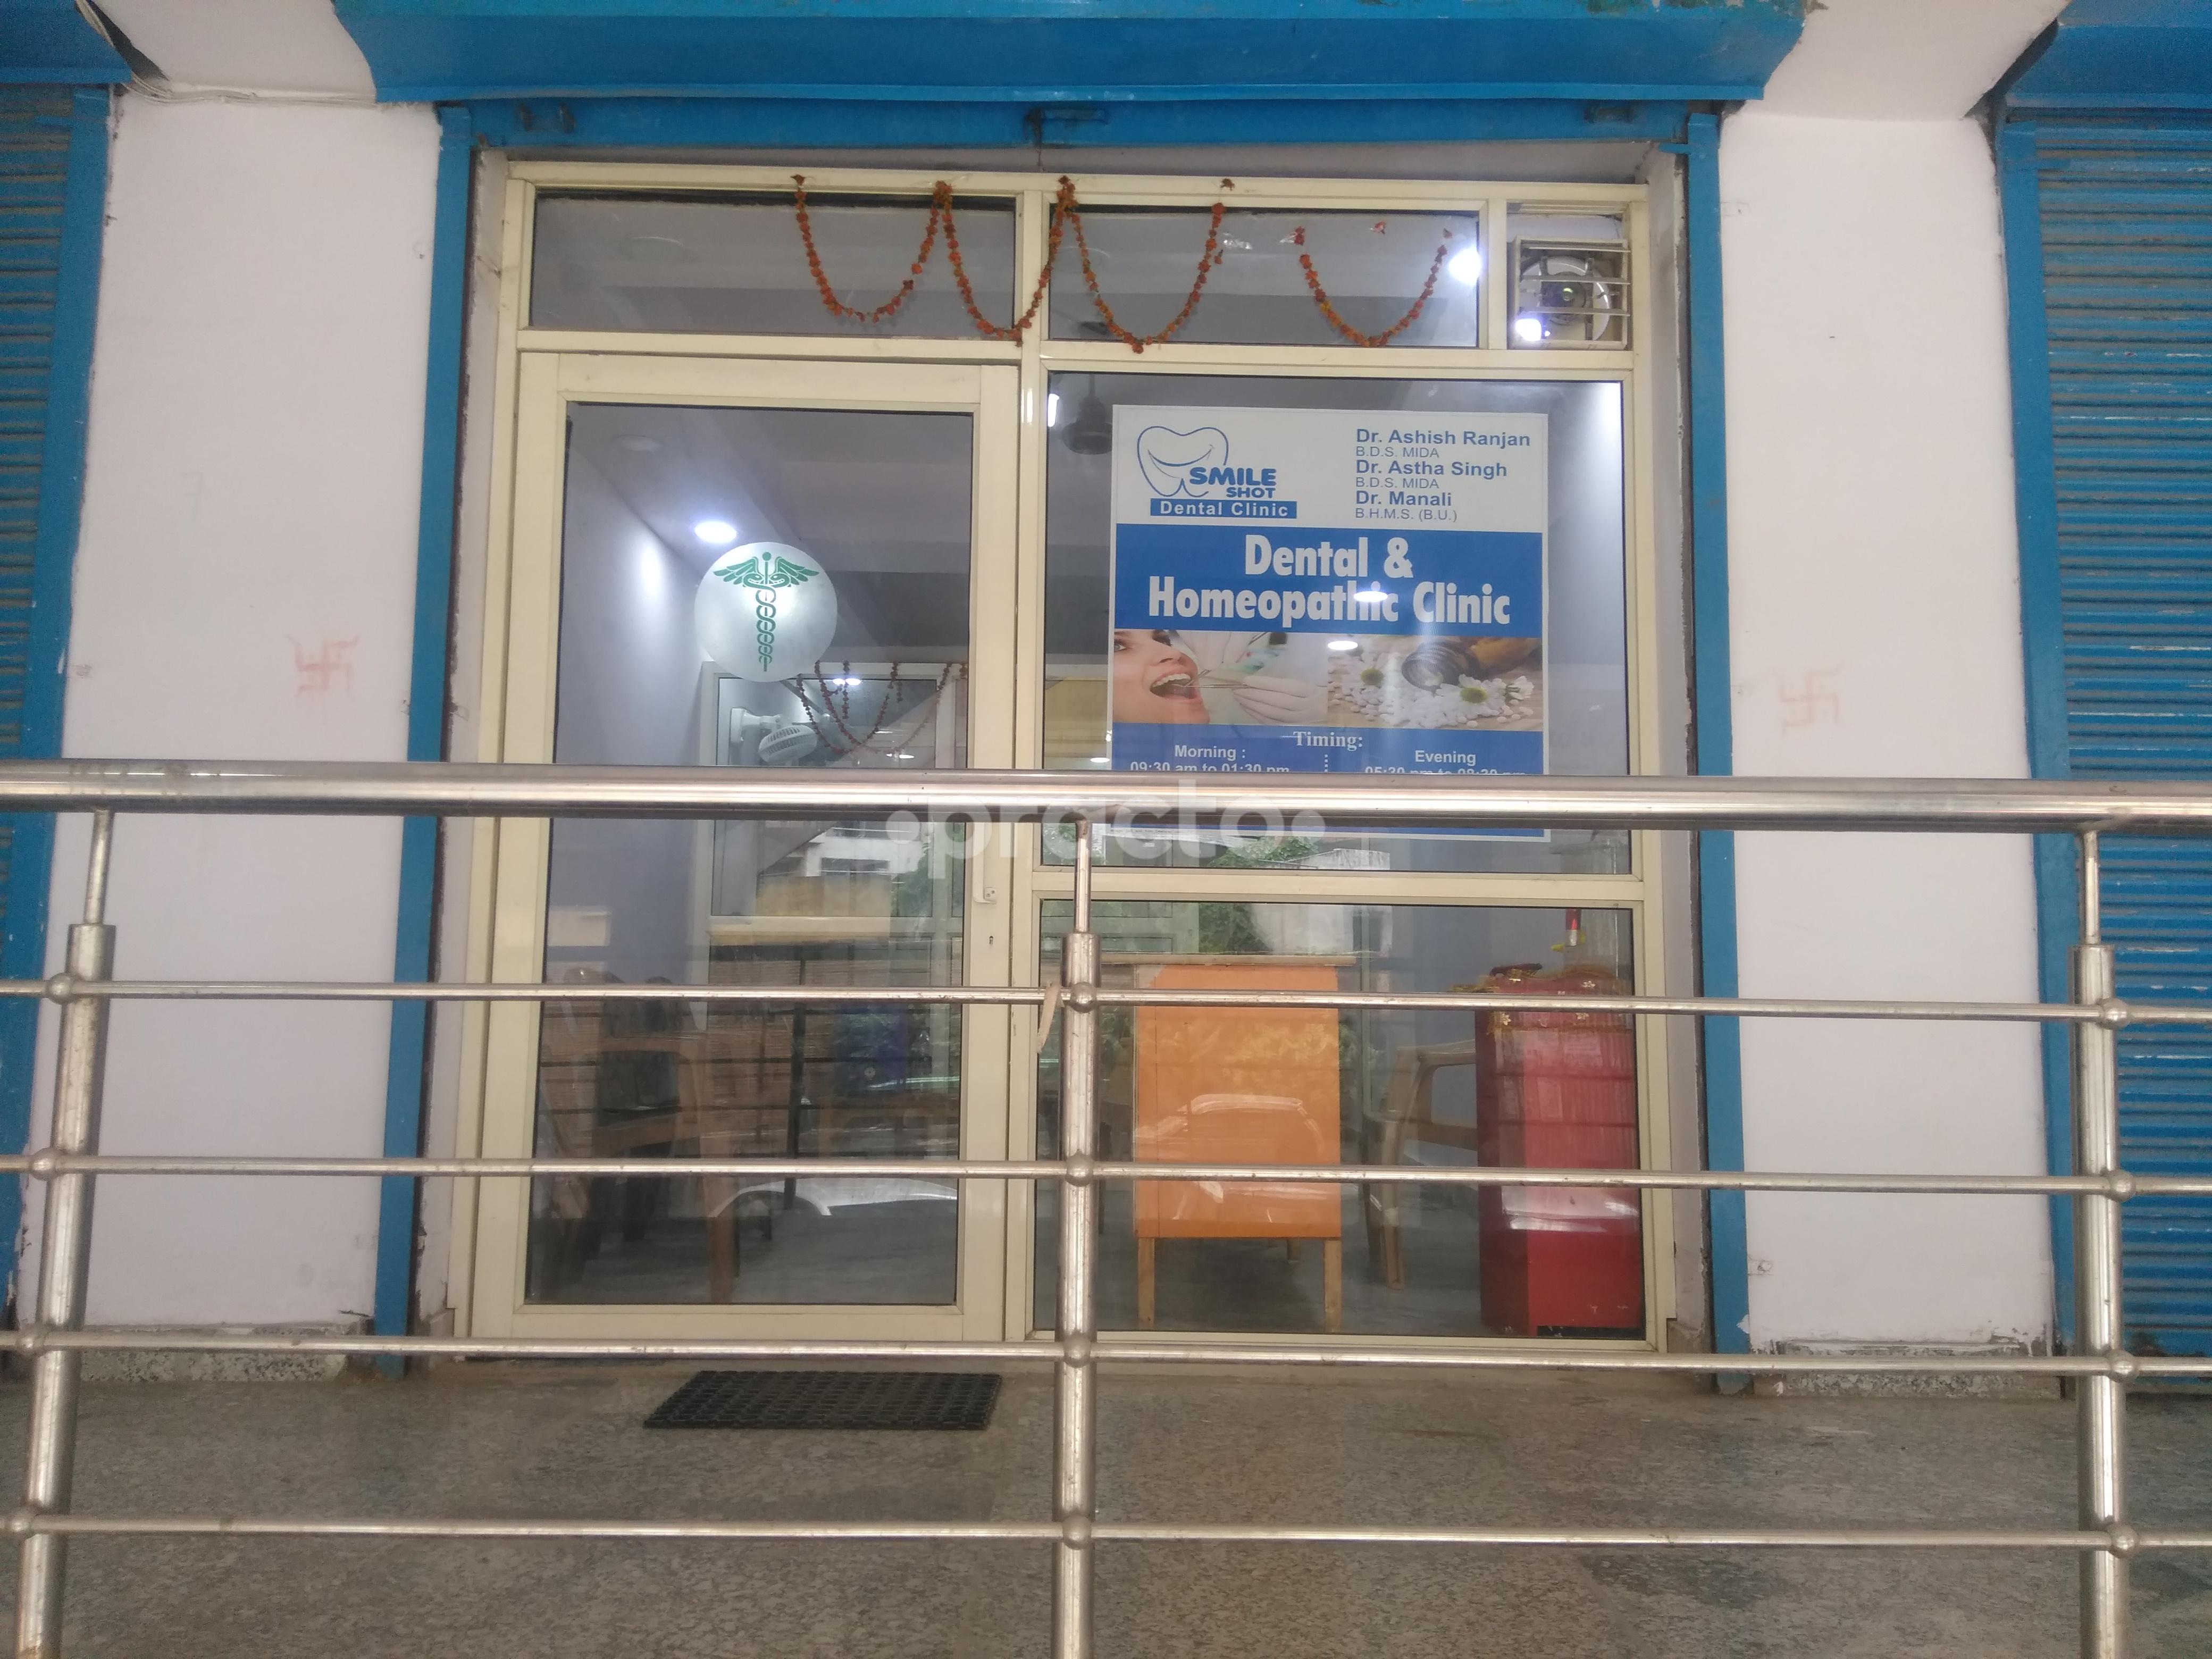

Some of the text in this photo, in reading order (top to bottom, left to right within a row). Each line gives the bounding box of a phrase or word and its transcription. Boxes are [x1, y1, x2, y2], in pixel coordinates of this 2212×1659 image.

[1356, 429, 1530, 449] Dr. Ashish Ranjan
[1355, 446, 1439, 458] B.D.S. MIDA
[1189, 467, 1277, 486] SMILE
[1356, 459, 1506, 480] Dr. Astha Singh
[1355, 477, 1439, 489] B.D.S. MIDA
[1226, 487, 1276, 498] SHOT
[1356, 490, 1451, 506] Dr. Manali
[1160, 501, 1288, 516] Dental Clinic
[1355, 508, 1457, 522] B.H.M.S. (B.U.)
[1245, 534, 1413, 578] Dental &
[1149, 576, 1510, 628] Homeopathic Clinic
[1293, 731, 1362, 751] Timing:
[1175, 745, 1236, 761] Morning
[1415, 750, 1476, 766] Evening
